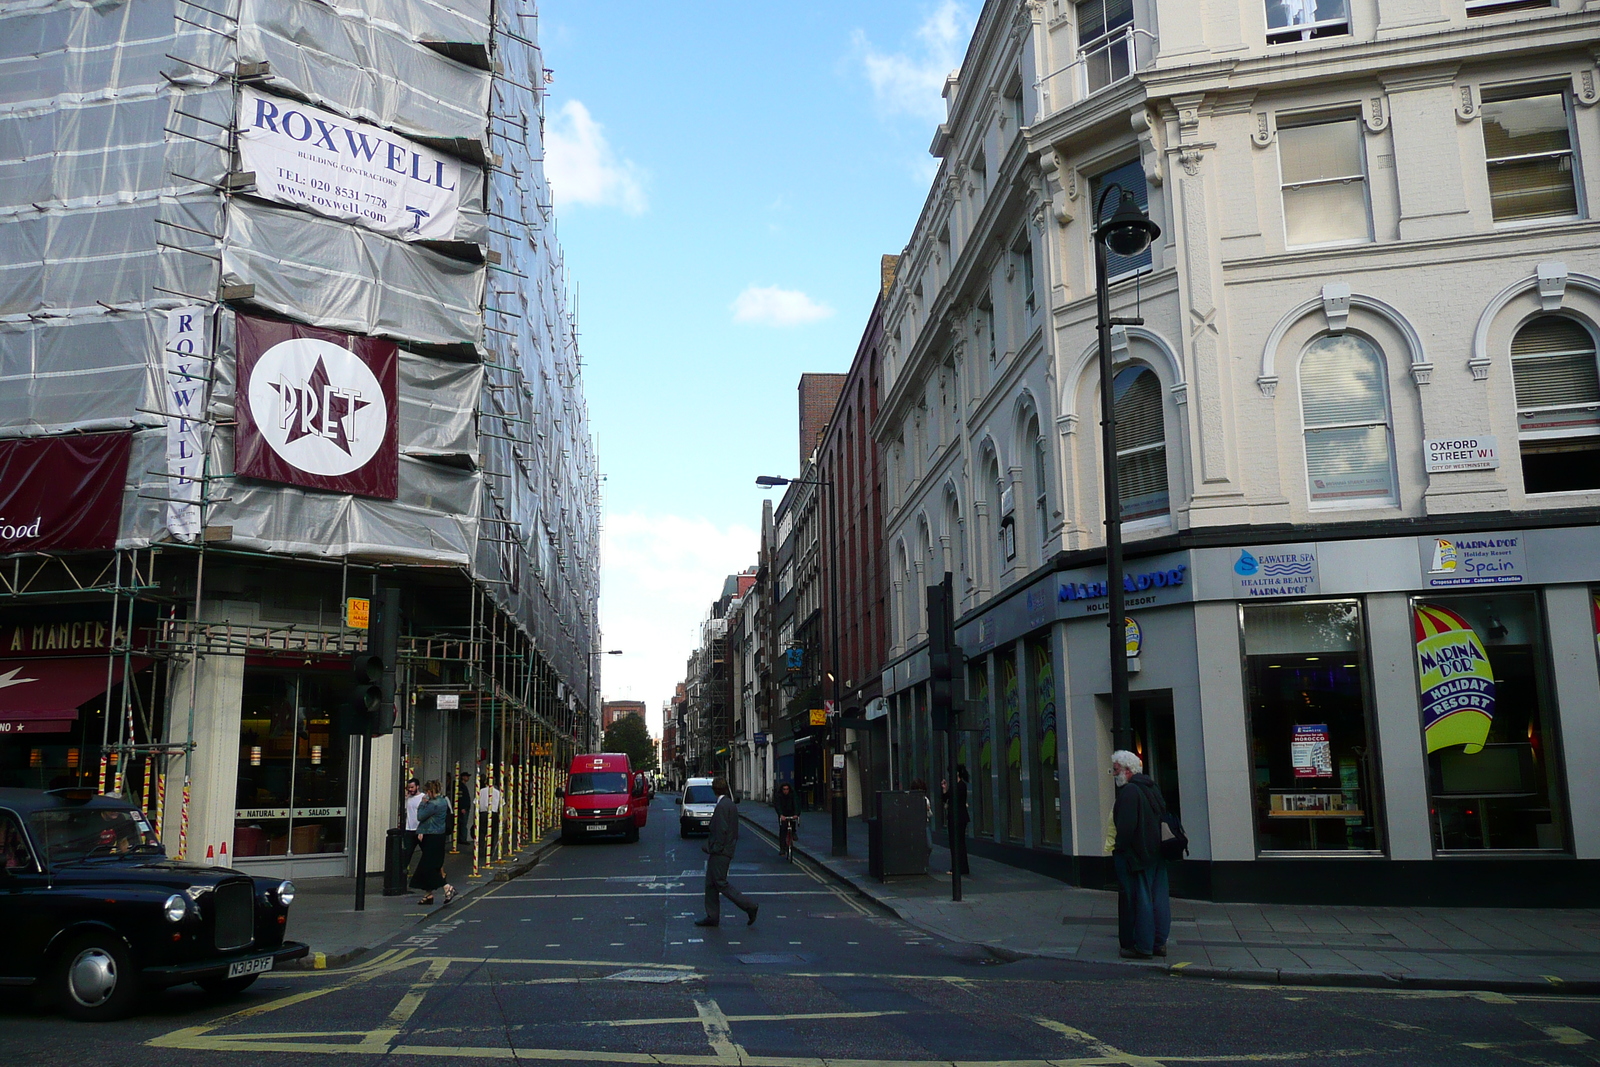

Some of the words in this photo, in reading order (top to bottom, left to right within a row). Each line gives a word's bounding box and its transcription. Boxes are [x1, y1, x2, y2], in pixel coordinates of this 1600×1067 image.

[252, 97, 456, 192] ROXWELL
[298, 150, 339, 169] BUILDING
[340, 164, 397, 187] CONTRACTORS
[277, 166, 306, 185] TEL:
[310, 178, 331, 193] 020
[335, 185, 360, 201] 8531
[364, 192, 387, 209] 7778
[276, 183, 387, 223] www.roxwell.com
[174, 314, 197, 486] ROXWELL
[279, 372, 361, 443] PRET
[1430, 439, 1478, 451] OXFORD
[1431, 450, 1474, 461] STREET
[1477, 449, 1493, 458] W1
[1456, 539, 1496, 550] MARINA
[1496, 539, 1517, 548] D'OR
[1300, 553, 1315, 562] SPA
[1464, 558, 1514, 576] Spain
[1137, 569, 1183, 591] D'OR
[1241, 578, 1274, 586] HEALTH
[1283, 576, 1315, 584] BEAUTY
[1125, 596, 1156, 606] RESORT
[10, 624, 23, 651] A
[32, 620, 105, 650] MANGER
[1420, 640, 1486, 675] MARINA
[1439, 658, 1474, 678] D'OR
[1430, 679, 1489, 700] HOLIDAY
[1432, 695, 1490, 716] RESORT
[247, 810, 275, 818] NATURAL
[308, 808, 330, 816] SALADS
[231, 957, 271, 976] N313PYF
